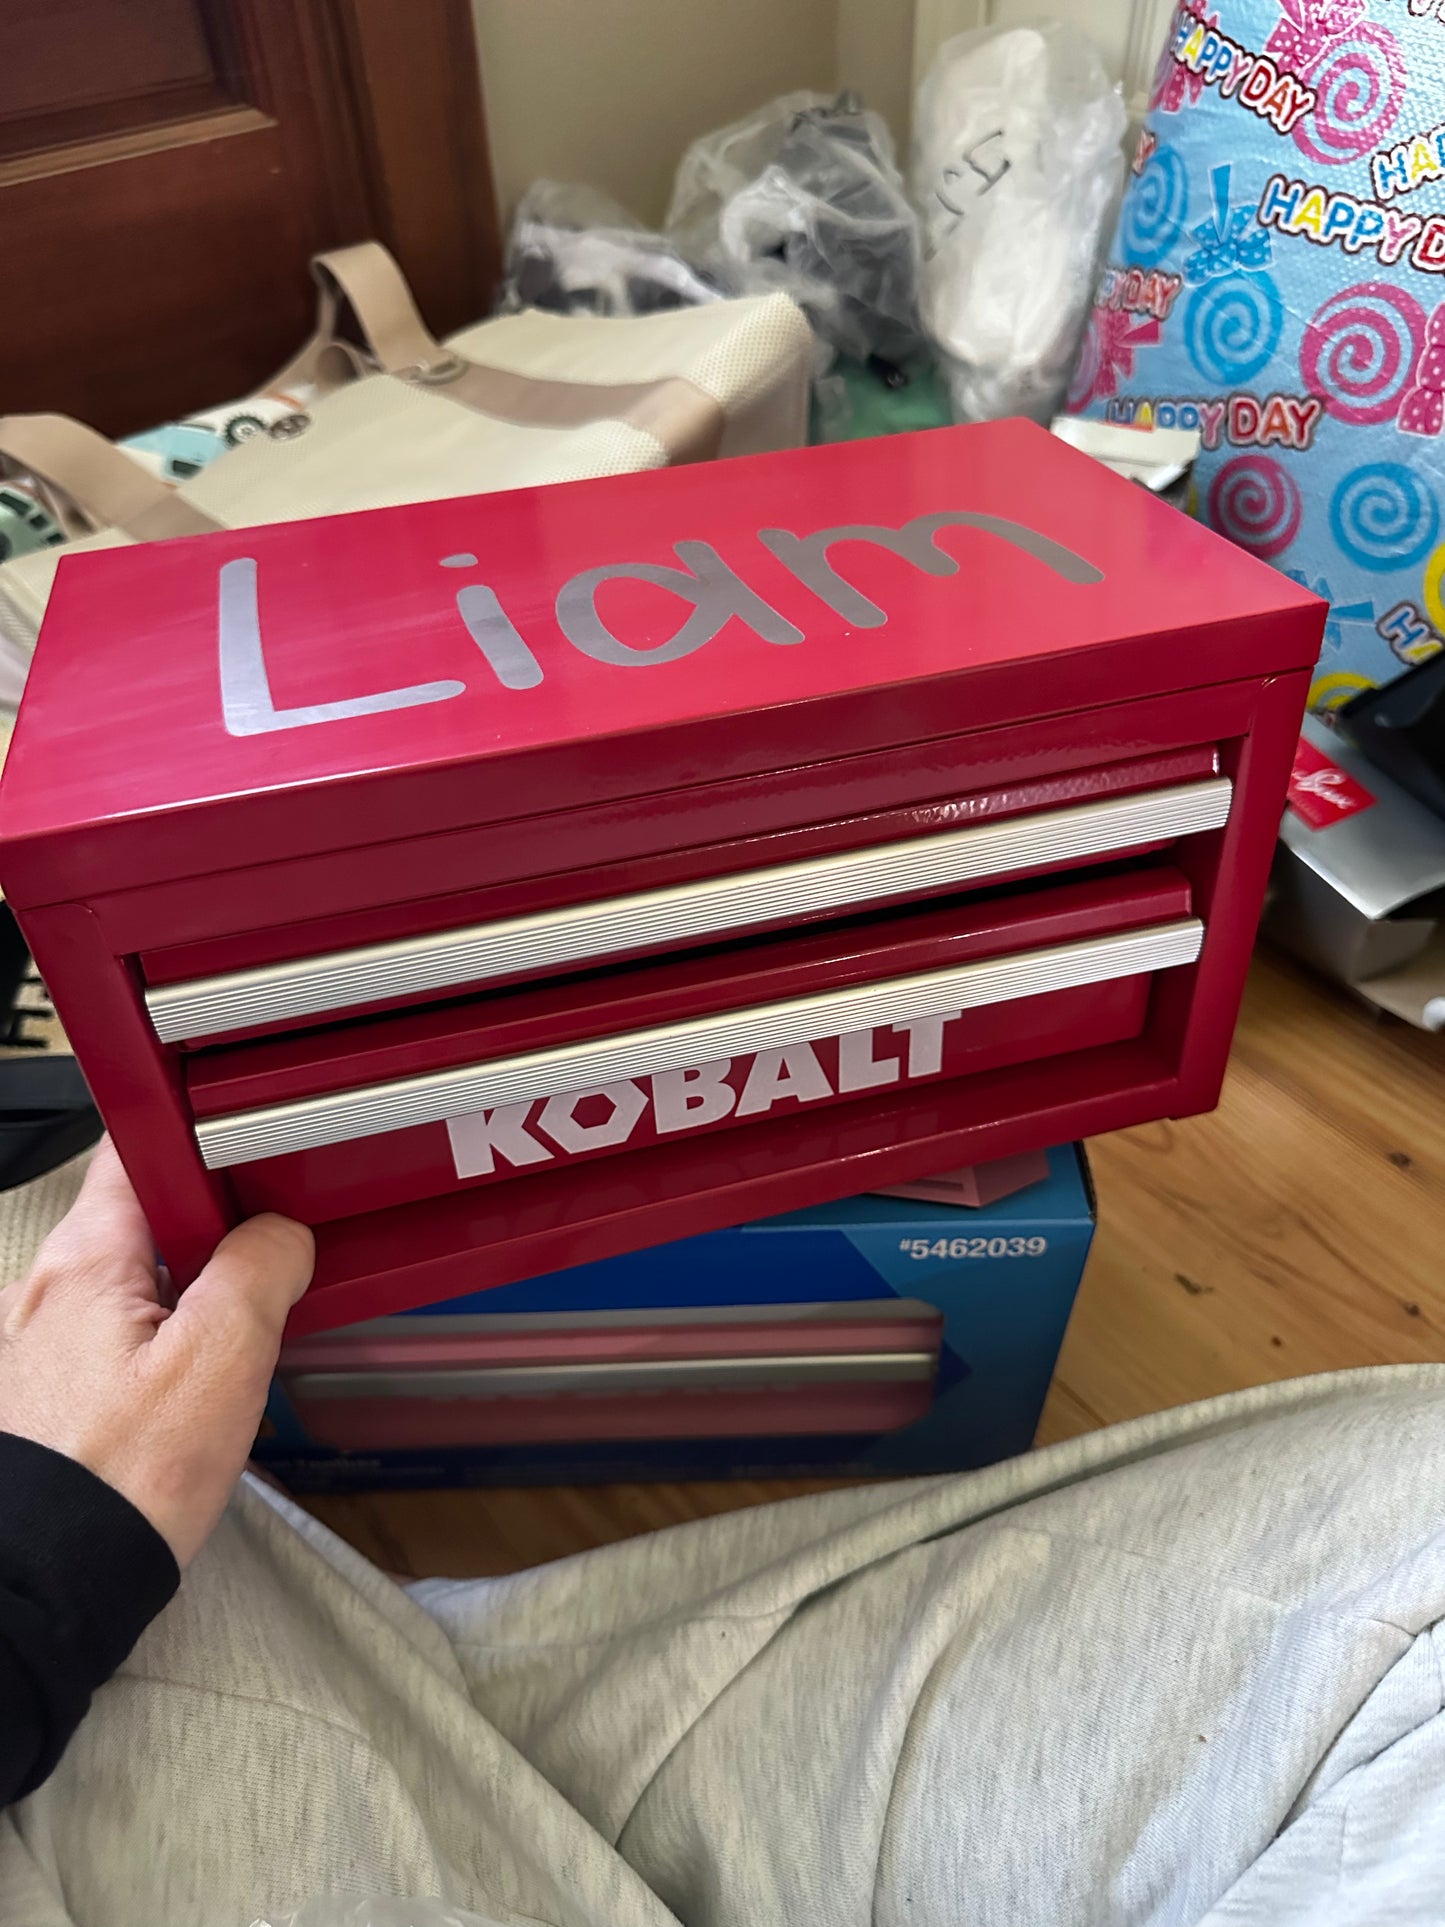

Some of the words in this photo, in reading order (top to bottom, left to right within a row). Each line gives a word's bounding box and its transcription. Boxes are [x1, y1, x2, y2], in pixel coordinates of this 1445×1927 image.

[1174, 12, 1253, 97] HAPPY
[1240, 58, 1315, 132] DAY
[1259, 176, 1421, 264] HAPPY
[1123, 267, 1182, 319] DAY
[1228, 396, 1320, 449] DAY
[218, 510, 1106, 737] Liam
[445, 1009, 962, 1180] KOBALT
[900, 1236, 1047, 1261] #5462039
